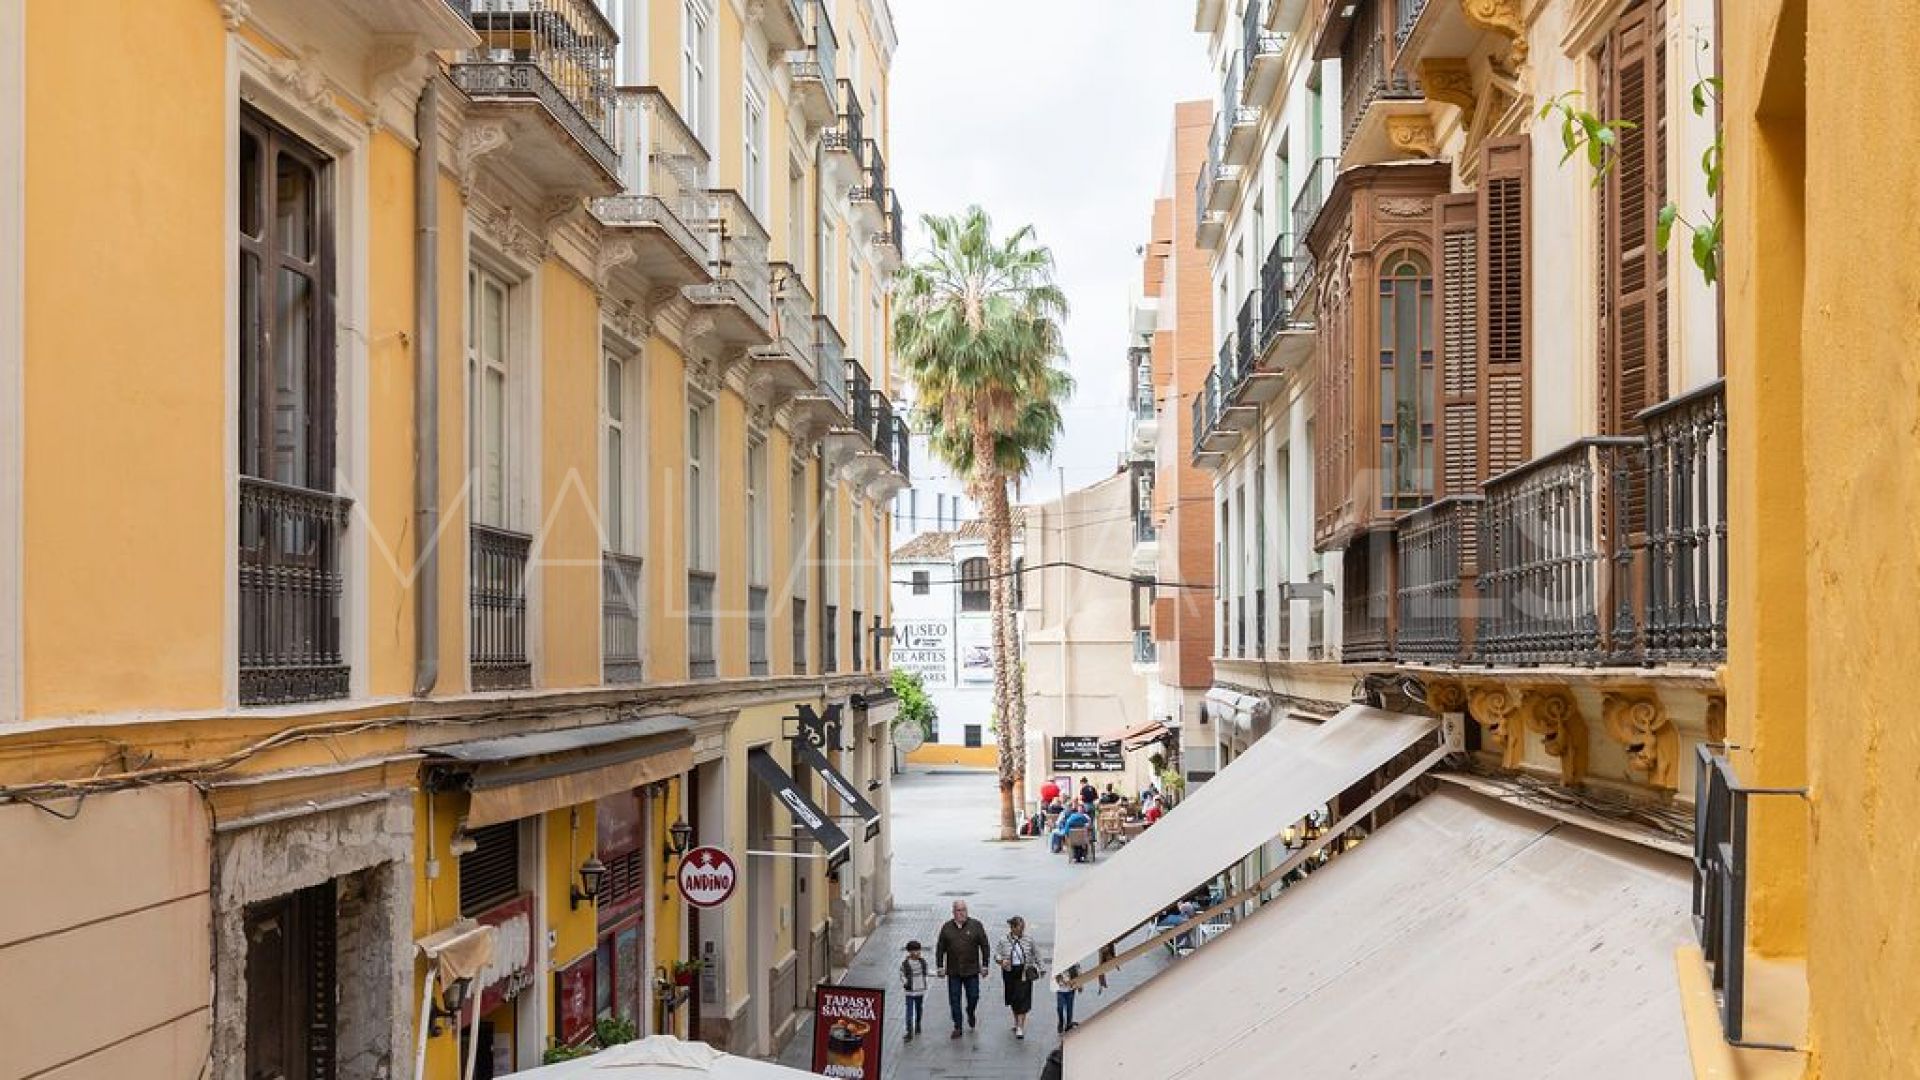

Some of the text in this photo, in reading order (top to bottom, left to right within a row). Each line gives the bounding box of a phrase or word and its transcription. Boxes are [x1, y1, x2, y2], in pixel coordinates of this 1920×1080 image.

[893, 624, 948, 648] MUSEO
[892, 652, 946, 662] DE ARTES
